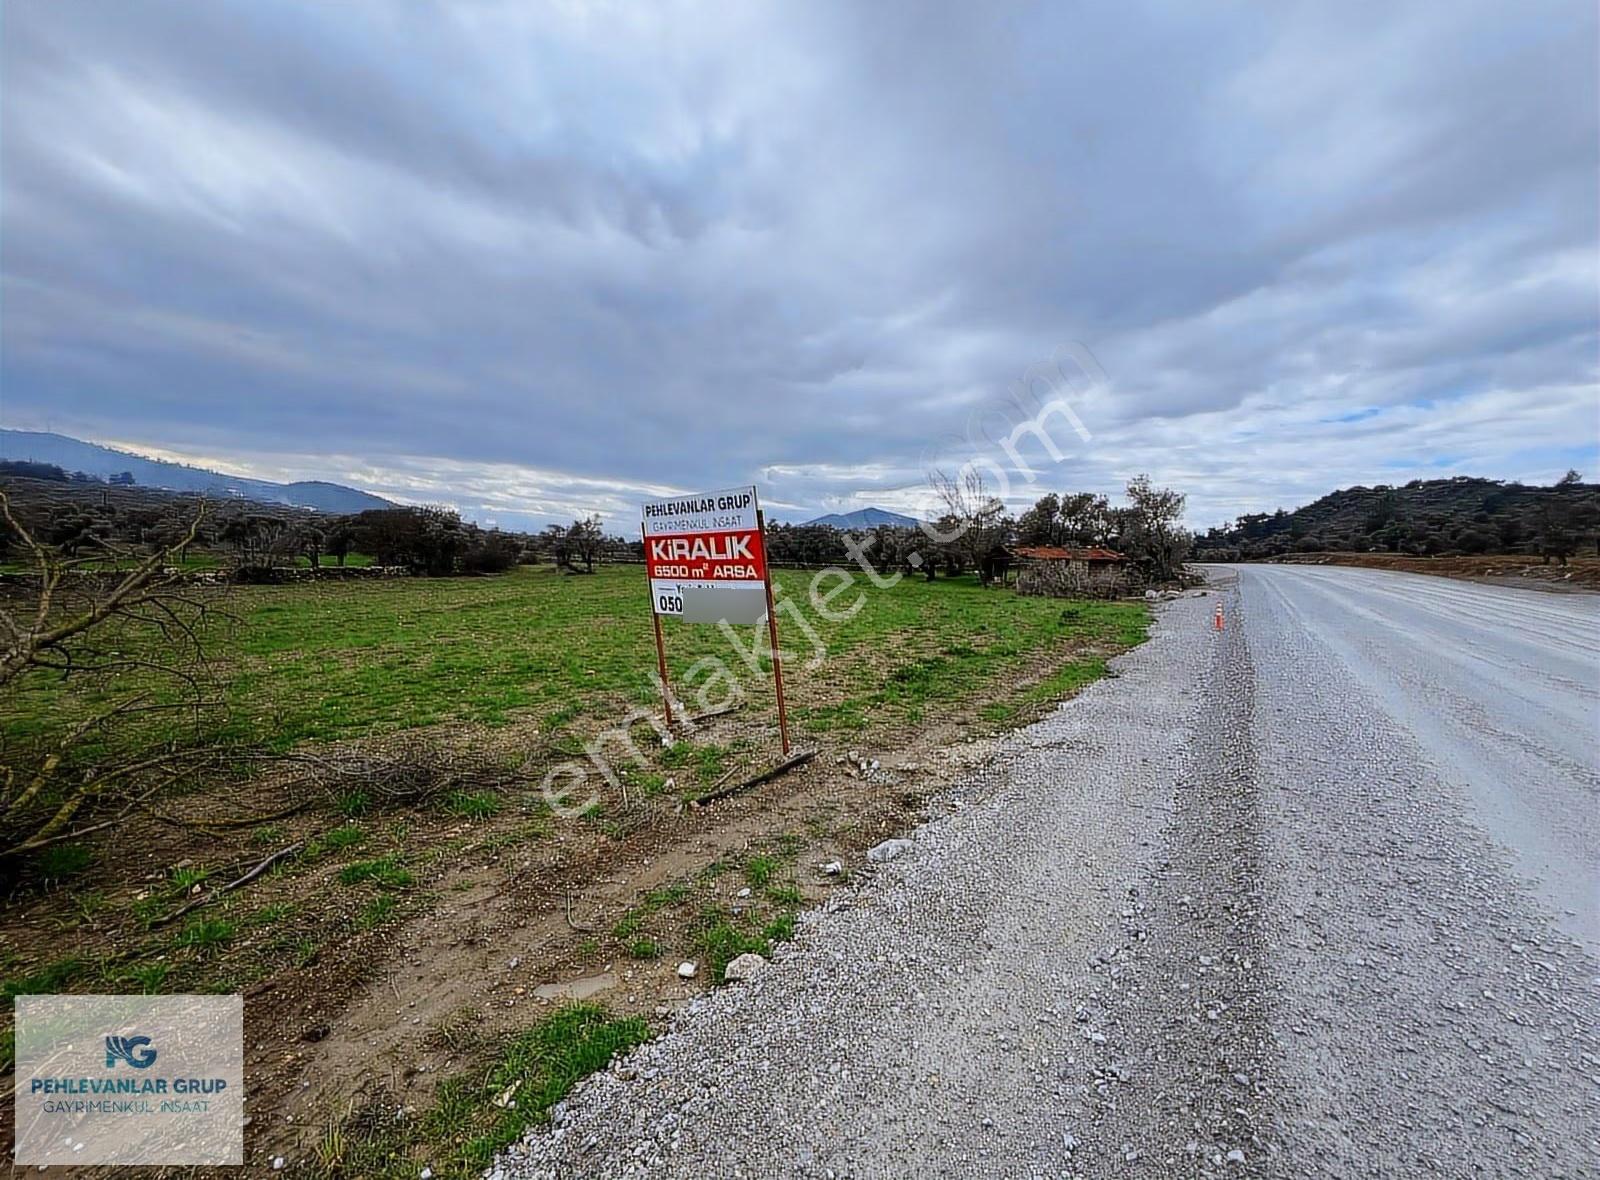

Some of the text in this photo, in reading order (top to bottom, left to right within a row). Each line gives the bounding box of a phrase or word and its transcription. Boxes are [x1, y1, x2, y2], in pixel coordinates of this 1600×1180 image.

[645, 494, 751, 518] PEHLEVANLAR GRUP
[654, 565, 689, 577] 6500
[712, 564, 758, 579] ARSA
